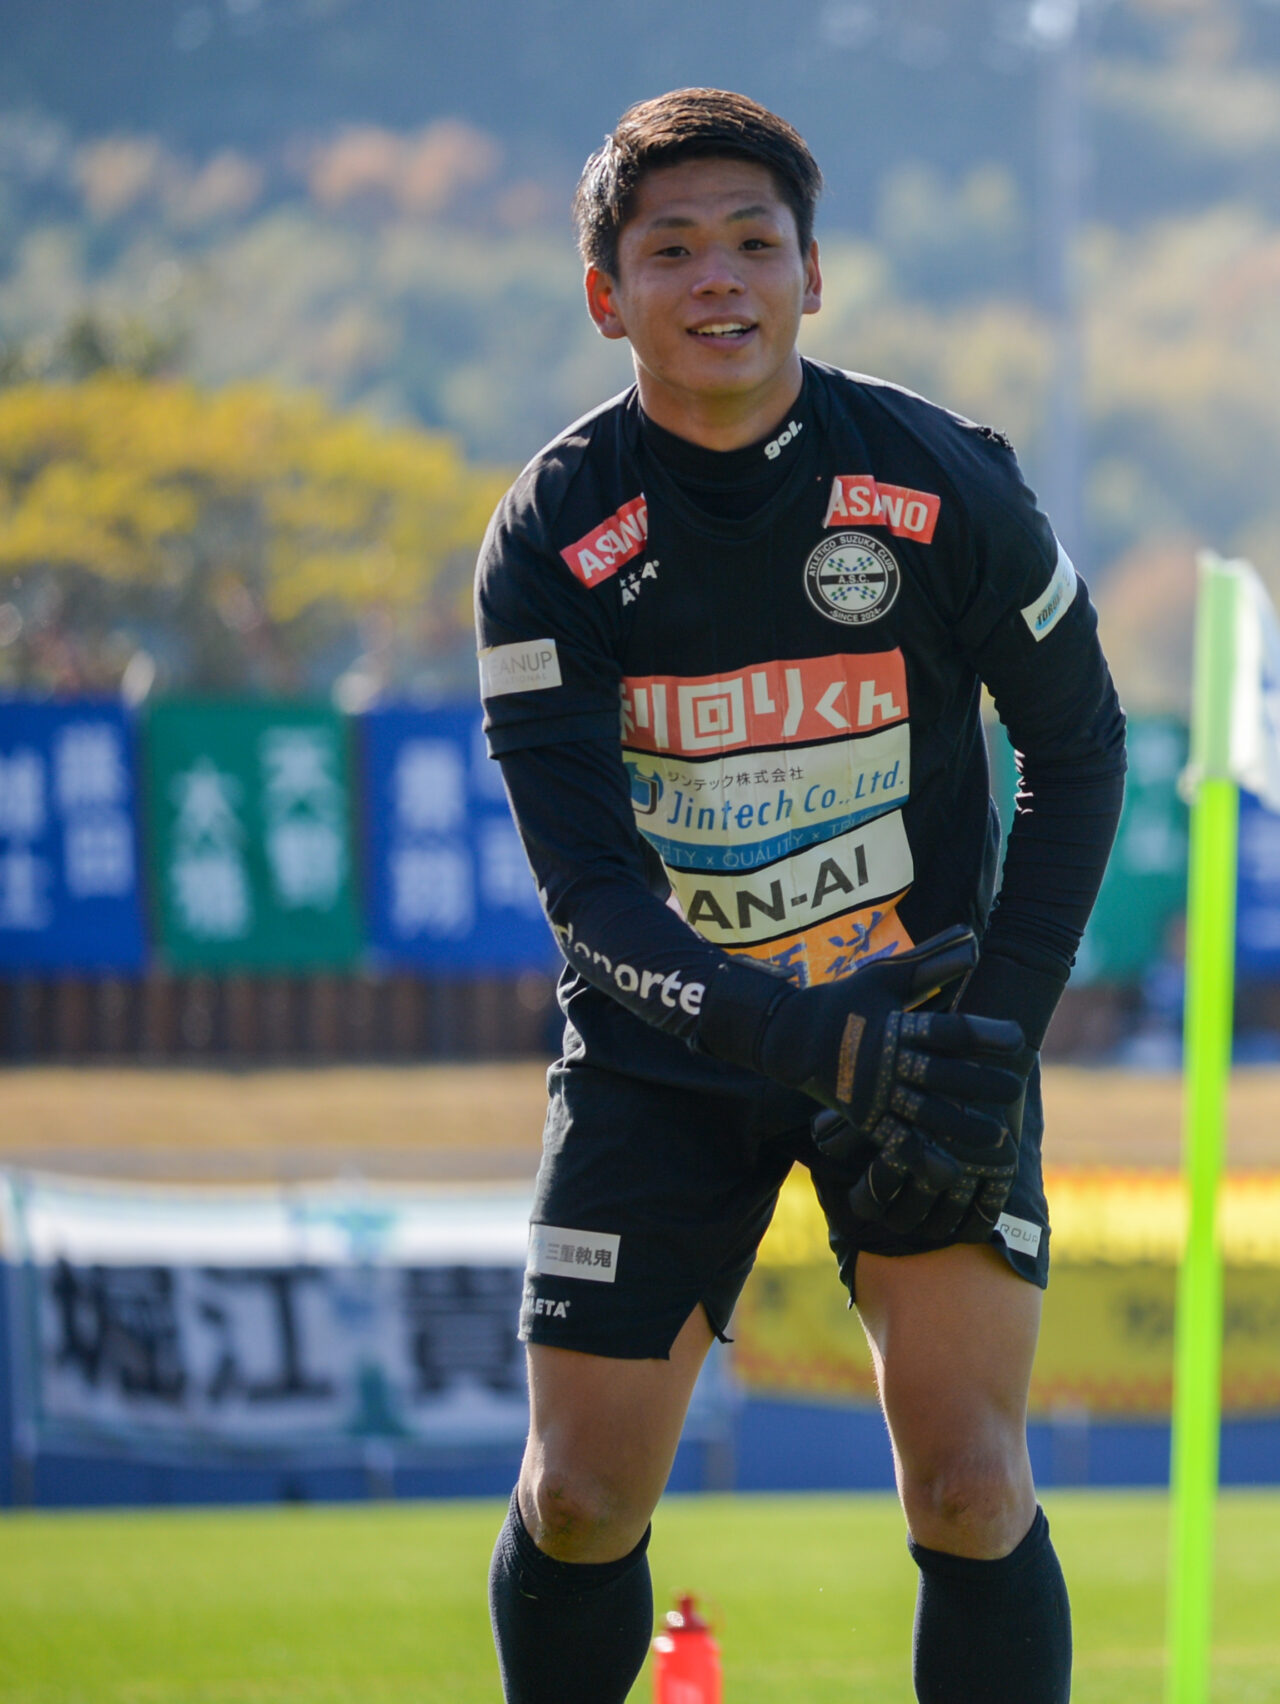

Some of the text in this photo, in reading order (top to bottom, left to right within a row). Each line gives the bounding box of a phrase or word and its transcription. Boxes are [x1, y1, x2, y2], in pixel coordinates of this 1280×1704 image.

[830, 486, 928, 533] ASANO
[839, 535, 876, 550] SUZUKA
[877, 548, 896, 572] CLUB
[667, 789, 793, 831] Jintech
[854, 760, 906, 800] Ltd.
[685, 844, 869, 930] AN-AI
[529, 1296, 568, 1319] LETA
